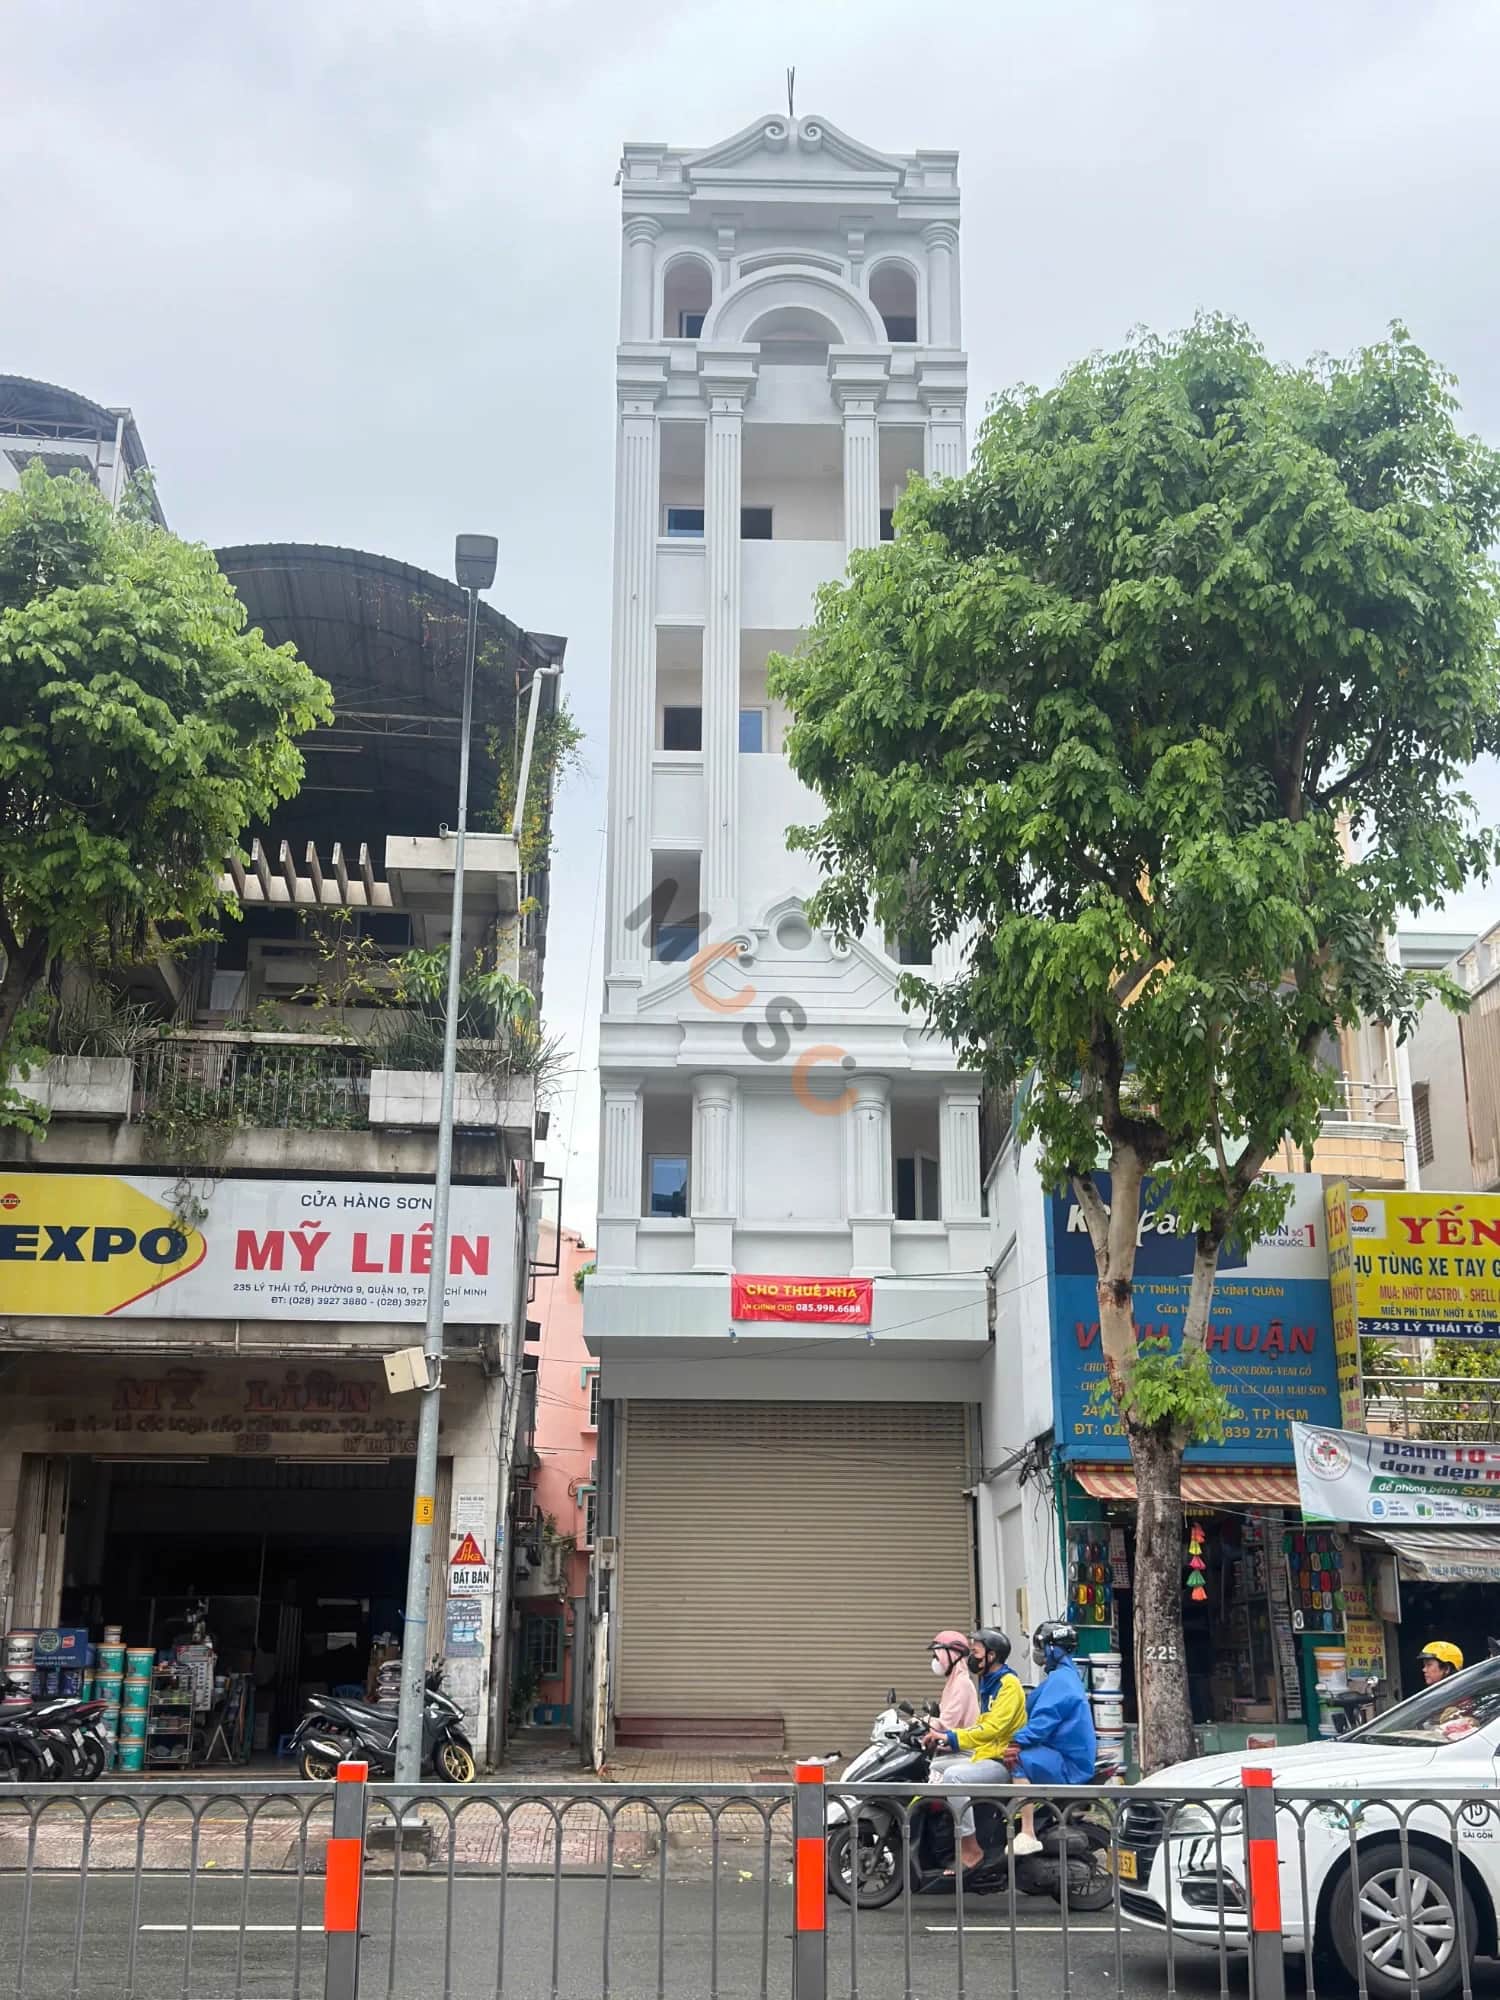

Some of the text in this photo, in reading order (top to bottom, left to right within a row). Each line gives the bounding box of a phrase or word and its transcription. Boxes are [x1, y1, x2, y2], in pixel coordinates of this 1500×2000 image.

[301, 1190, 432, 1210] CỬA HÀNG SƠN
[1304, 1223, 1316, 1248] 1
[0, 1225, 188, 1264] EXPO
[235, 1220, 490, 1275] MỸ LIÊN
[1378, 1252, 1423, 1276] TÙNG
[1429, 1258, 1448, 1276] XE
[1454, 1259, 1487, 1277] TAY
[233, 1283, 251, 1292] 235
[254, 1282, 265, 1292] LÝ
[268, 1282, 290, 1293] THÁI
[311, 1285, 353, 1294] PHƯỜNG
[356, 1286, 364, 1295] 9,
[368, 1286, 394, 1296] QUẬN
[445, 1287, 460, 1296] CHÍ
[463, 1288, 487, 1296] MINH
[747, 1285, 778, 1295] CHO
[784, 1283, 822, 1297] THUÊ
[1150, 1285, 1179, 1295] TNHH
[1427, 1287, 1464, 1301] CASTROL
[1471, 1289, 1496, 1302] SHELL
[271, 1296, 286, 1304] ĐT:
[289, 1296, 314, 1305] (028)
[377, 1299, 402, 1307] (028)
[1420, 1307, 1441, 1317] THAY
[1468, 1310, 1473, 1318] &
[1373, 1322, 1400, 1331] 243
[1404, 1320, 1423, 1332] LÝ
[1427, 1321, 1460, 1333] THÁI
[1205, 1319, 1316, 1360] HUẬN
[1252, 1408, 1270, 1420] TP
[1276, 1409, 1309, 1420] HCM
[1075, 1423, 1097, 1435] ĐT:
[1222, 1426, 1250, 1438] 839
[1256, 1428, 1278, 1439] 271
[423, 1506, 429, 1515] 5
[457, 1541, 481, 1562] Sika
[1147, 1646, 1177, 1661] 225
